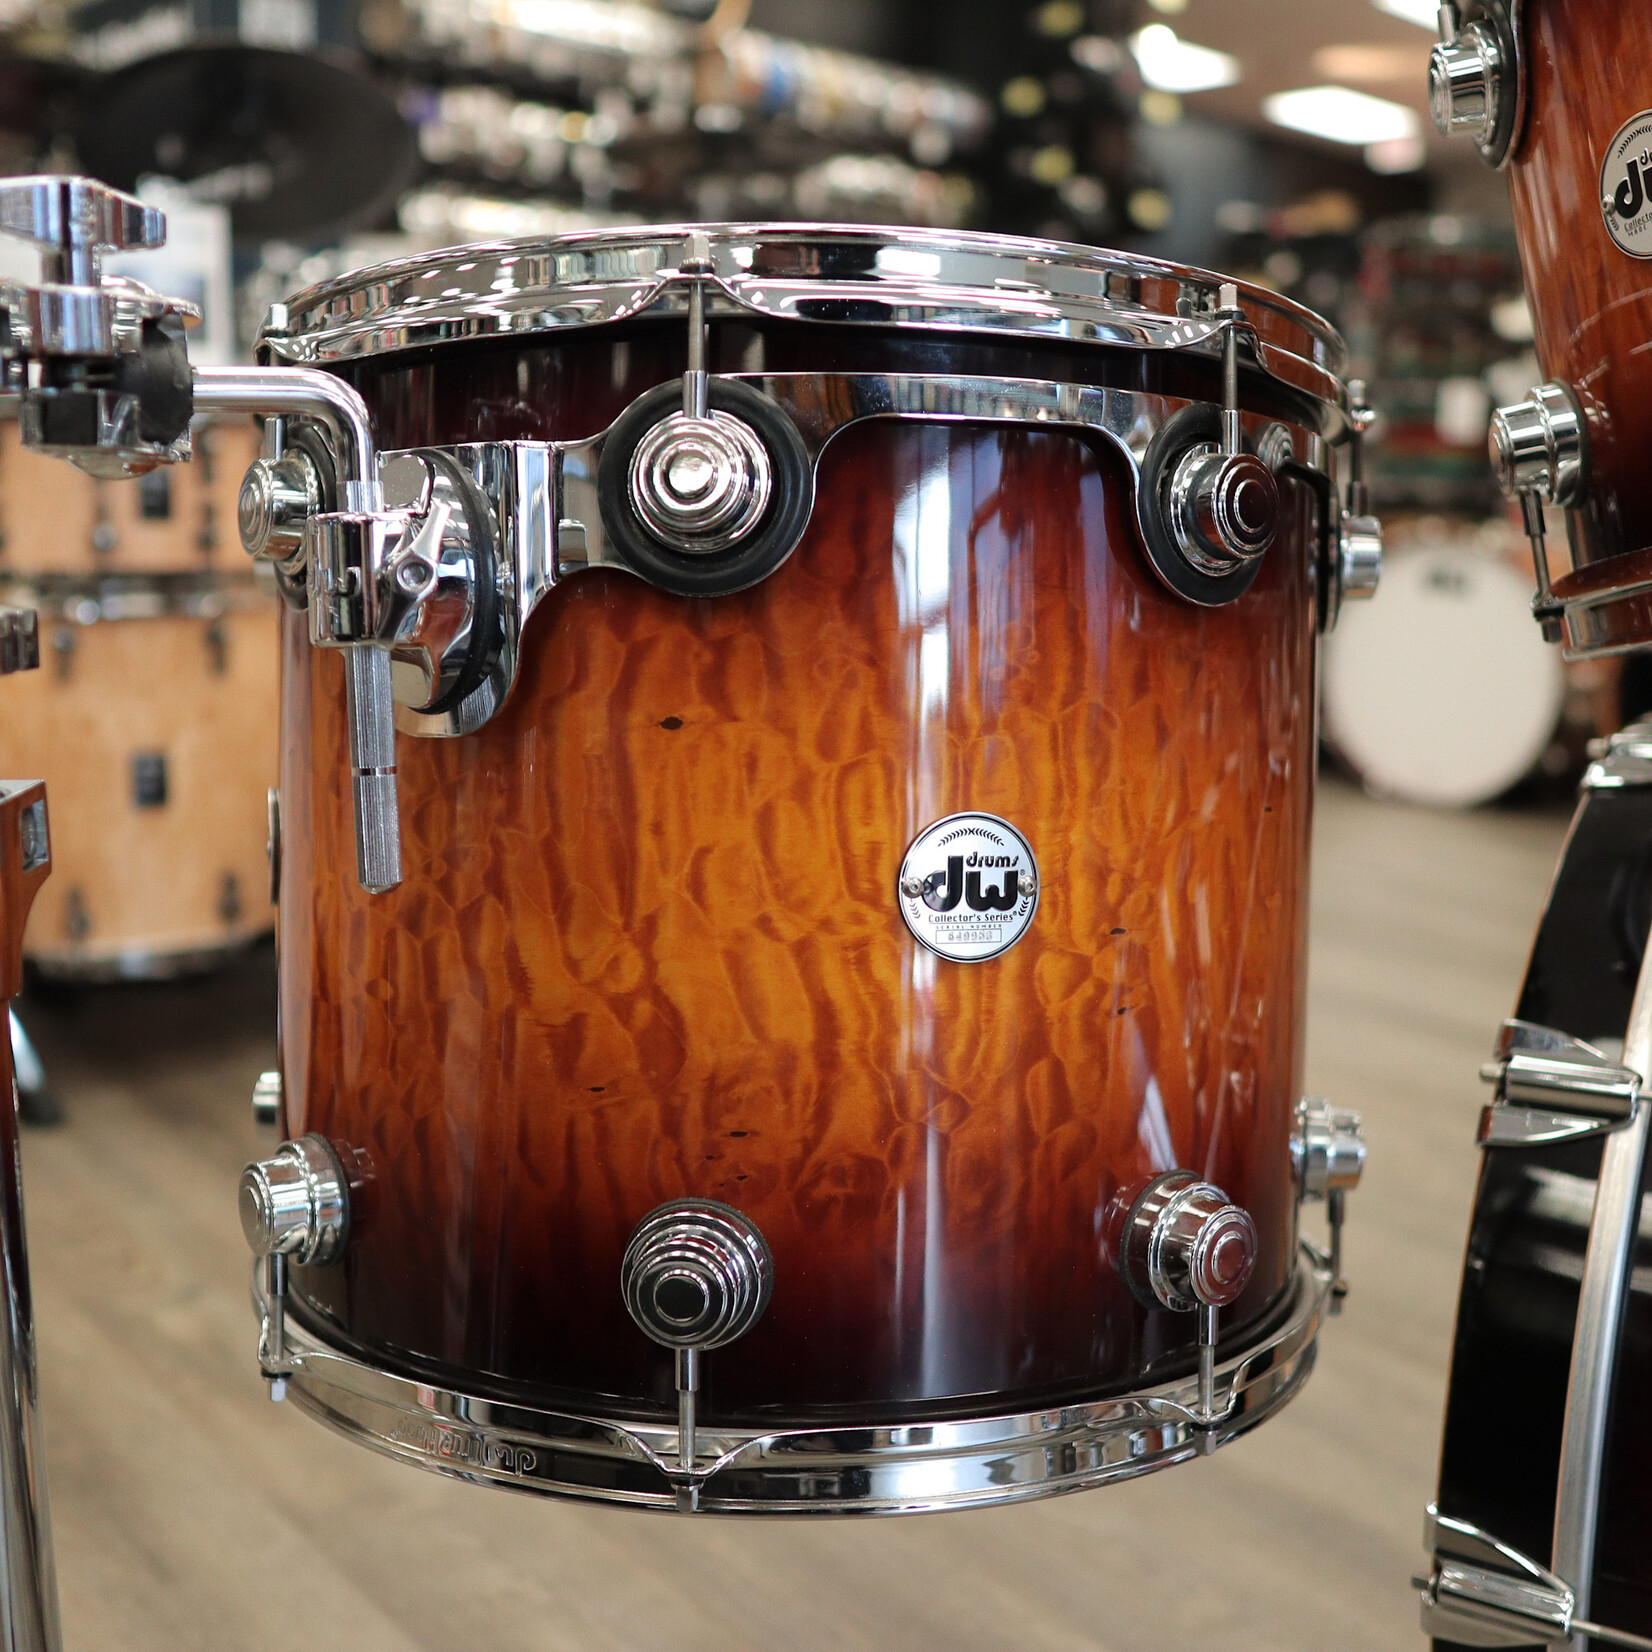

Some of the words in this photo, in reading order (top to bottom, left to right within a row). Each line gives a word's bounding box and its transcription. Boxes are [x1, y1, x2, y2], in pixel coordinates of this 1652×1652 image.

[1615, 158, 1652, 219] d
[966, 851, 1019, 868] drums
[928, 914, 981, 923] Collector's
